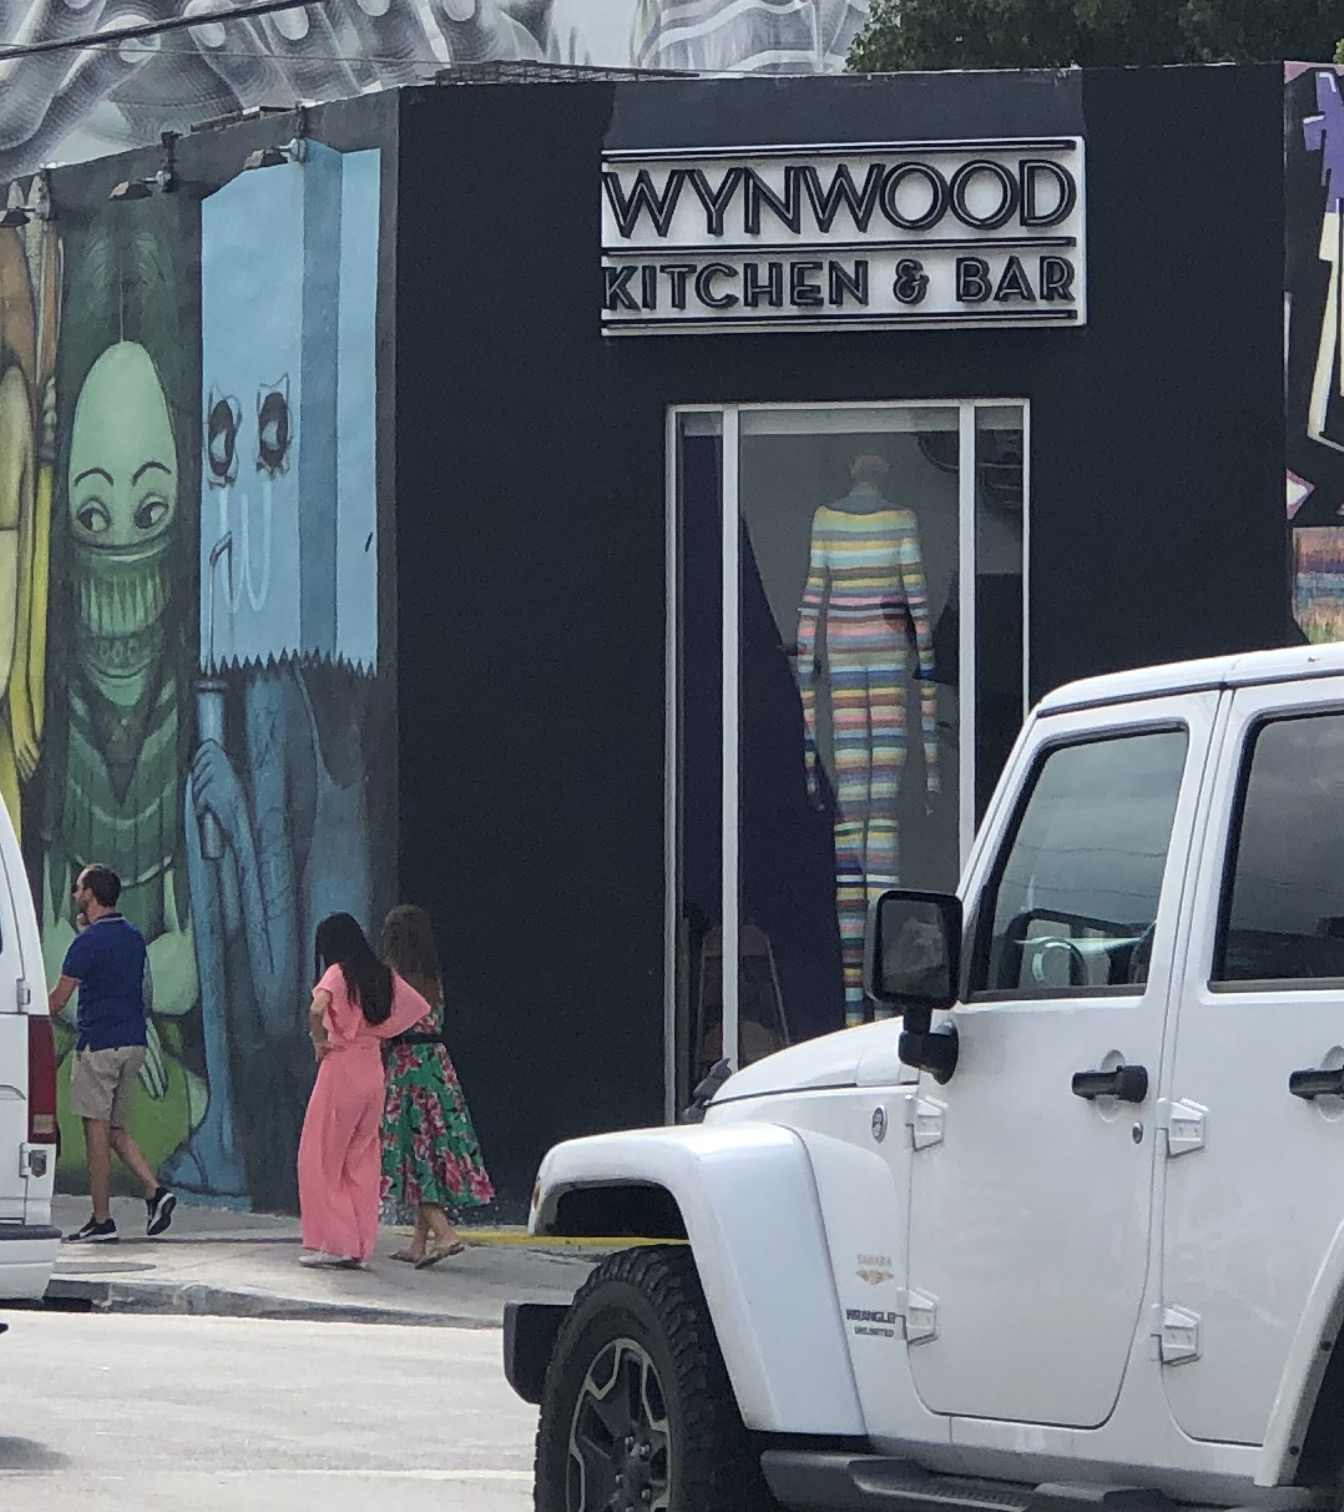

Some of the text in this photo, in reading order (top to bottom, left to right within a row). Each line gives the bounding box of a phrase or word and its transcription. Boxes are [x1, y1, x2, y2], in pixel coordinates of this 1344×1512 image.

[602, 160, 1076, 239] WYNWOOD
[602, 256, 1075, 312] KITCHEN & BAR
